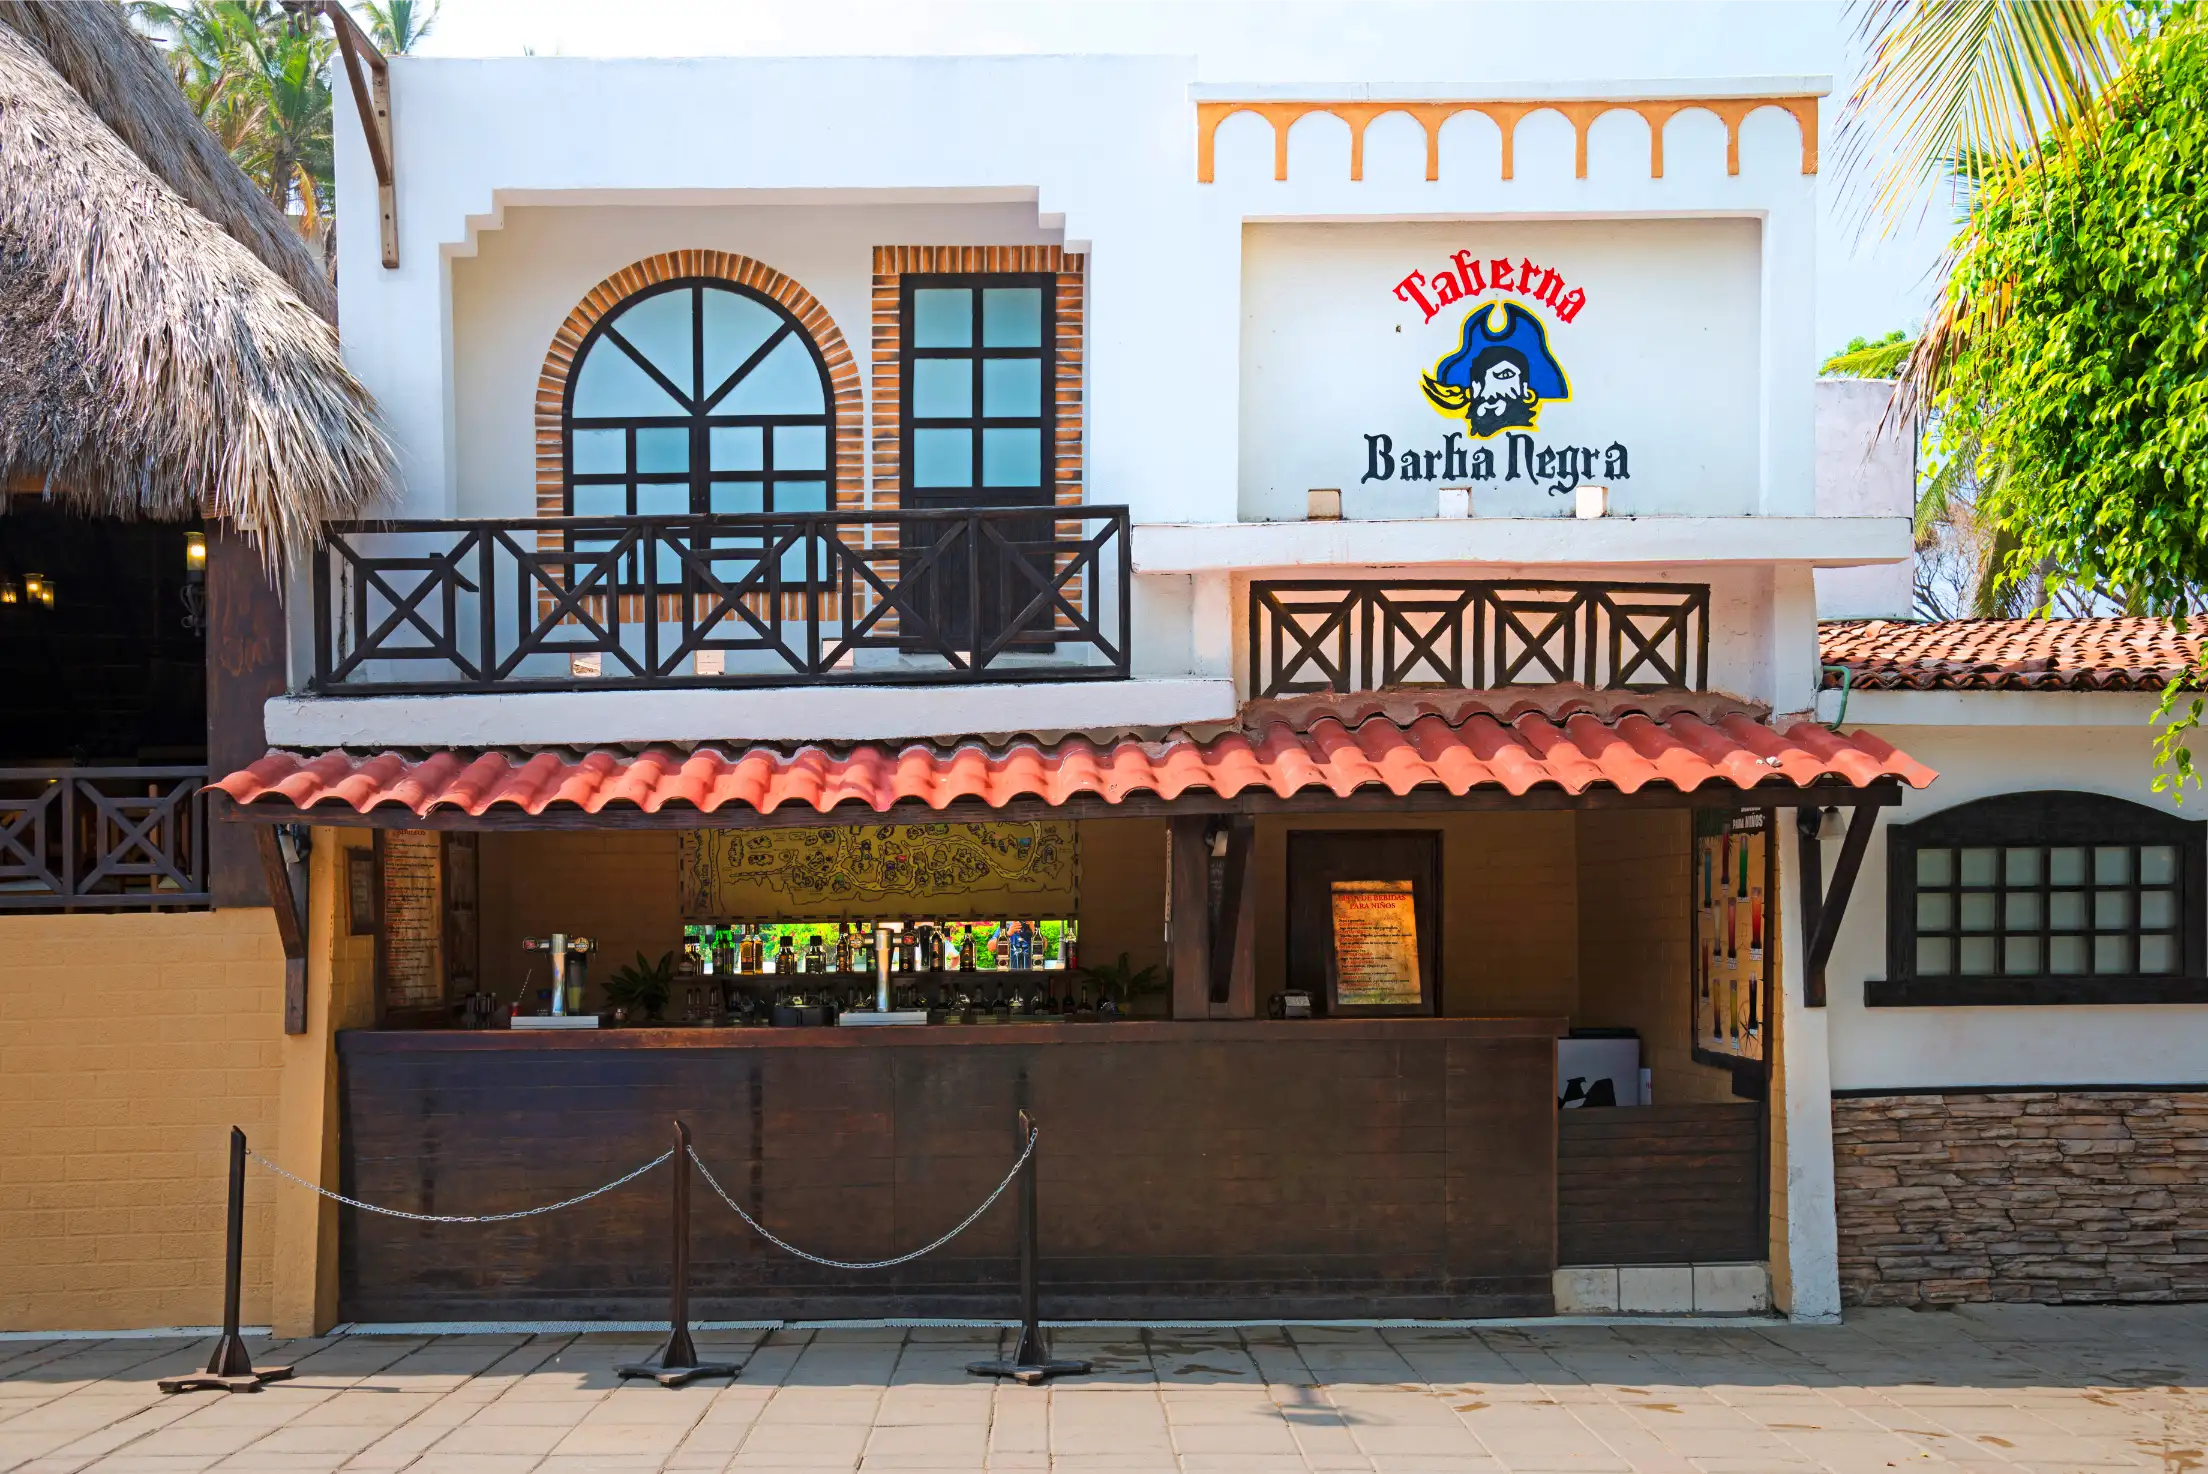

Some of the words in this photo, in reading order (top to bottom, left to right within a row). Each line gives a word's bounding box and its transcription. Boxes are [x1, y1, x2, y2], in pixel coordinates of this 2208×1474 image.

[1392, 249, 1586, 324] Taberna
[1361, 432, 1496, 484] Barba
[1504, 431, 1631, 496] Negra
[1371, 901, 1396, 909] NIÑOS
